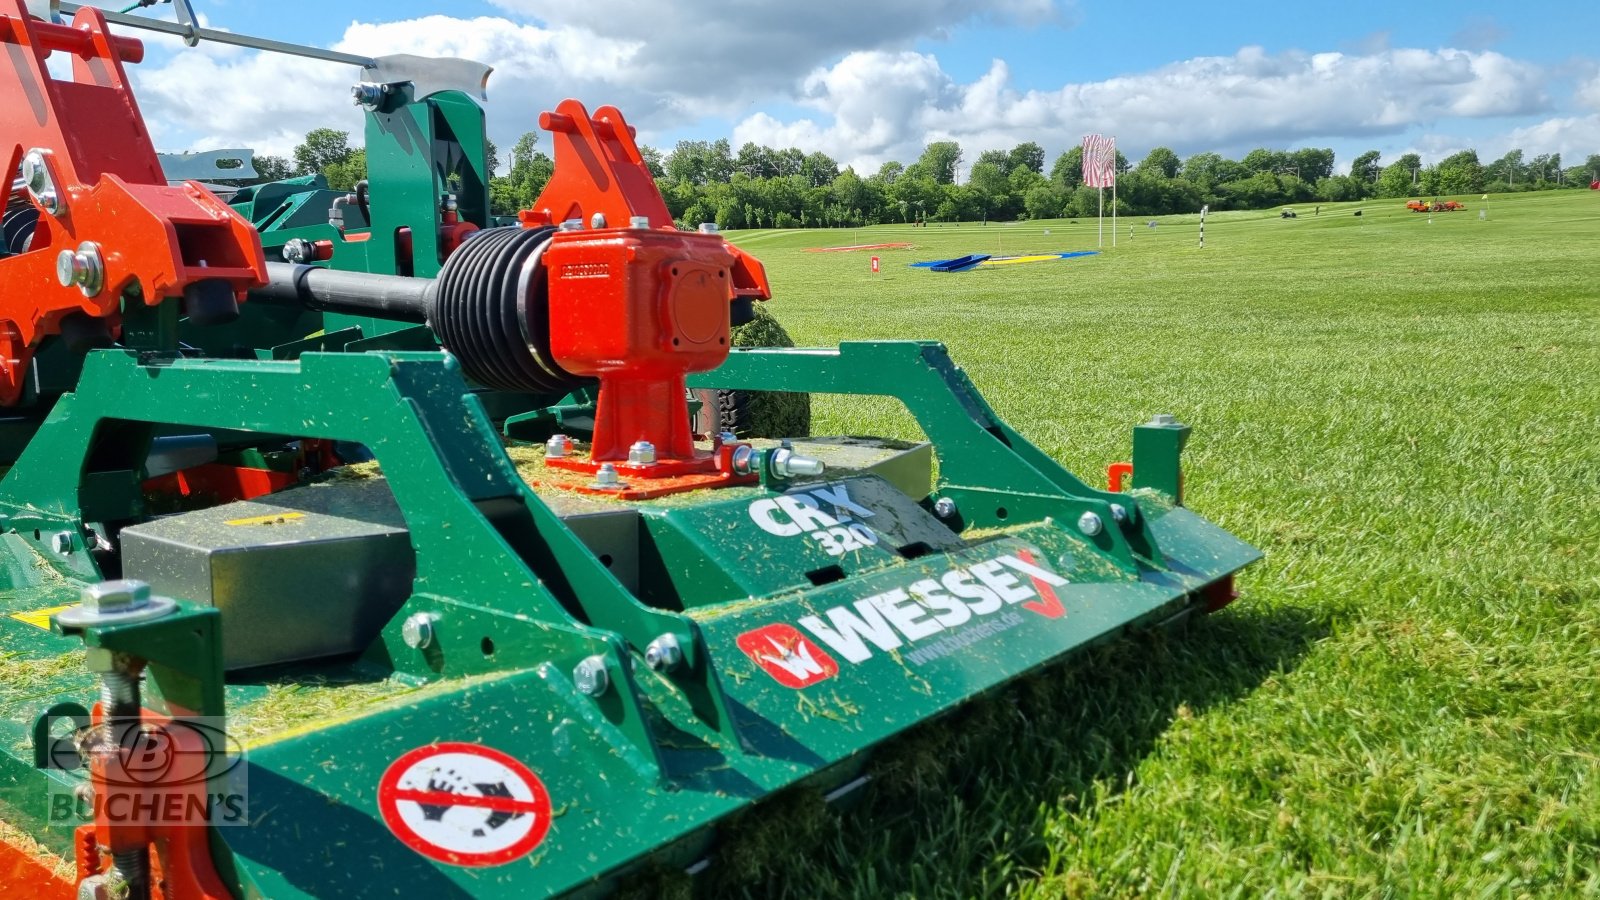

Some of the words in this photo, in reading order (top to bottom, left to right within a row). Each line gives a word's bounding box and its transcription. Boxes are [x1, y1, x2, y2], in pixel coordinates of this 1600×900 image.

[749, 484, 876, 537] CRX
[811, 523, 878, 556] 320
[798, 548, 1070, 664] WESSEX
[904, 611, 1024, 666] www.buchens.de
